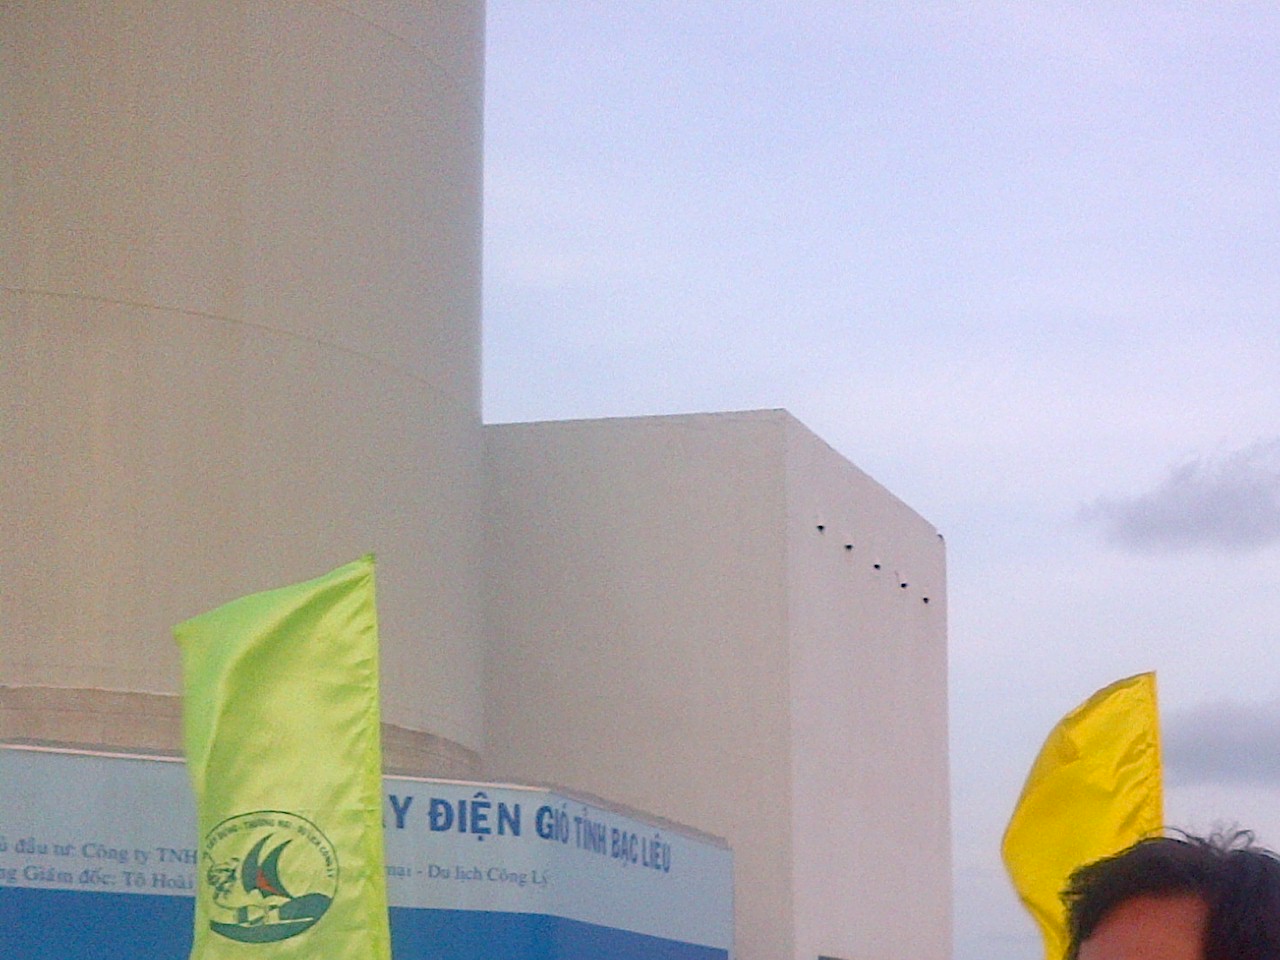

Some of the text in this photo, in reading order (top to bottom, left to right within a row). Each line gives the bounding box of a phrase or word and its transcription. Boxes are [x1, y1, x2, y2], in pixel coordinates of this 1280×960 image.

[382, 791, 672, 874] Y ĐIỆN GIÓ TỈNH BẠC LIÊU
[82, 843, 129, 864] Công
[156, 847, 198, 865] TNH
[487, 866, 529, 888] Công
